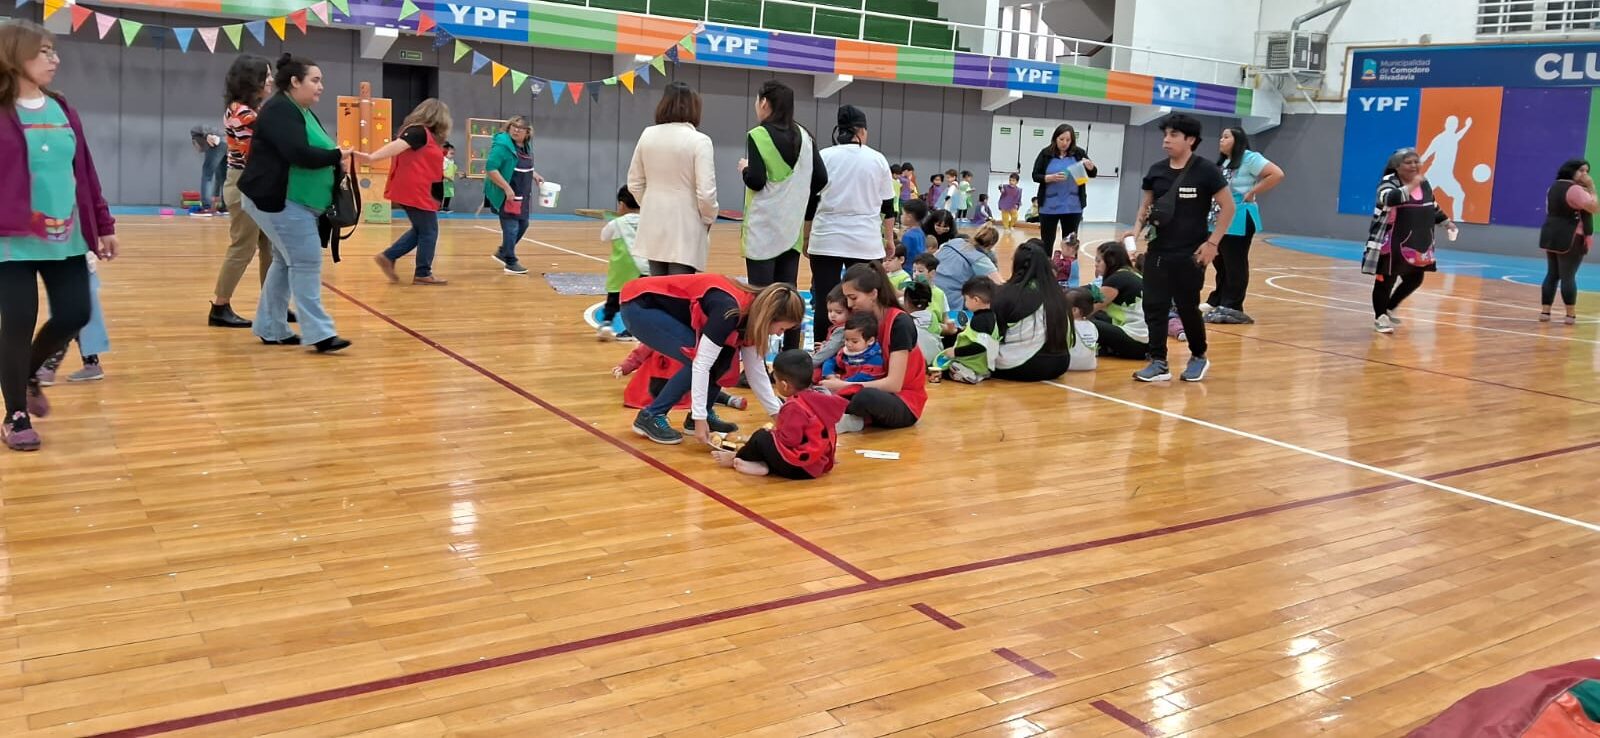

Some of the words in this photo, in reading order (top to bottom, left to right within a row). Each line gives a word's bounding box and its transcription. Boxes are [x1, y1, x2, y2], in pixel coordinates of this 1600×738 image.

[447, 3, 517, 29] YPF
[705, 33, 759, 55] YPF
[1380, 59, 1431, 67] Municipalidad
[1390, 66, 1430, 74] Comodoro
[1535, 52, 1600, 80] CLU
[1015, 66, 1053, 84] YPF
[1157, 84, 1191, 100] YPF
[1359, 96, 1409, 112] YPF
